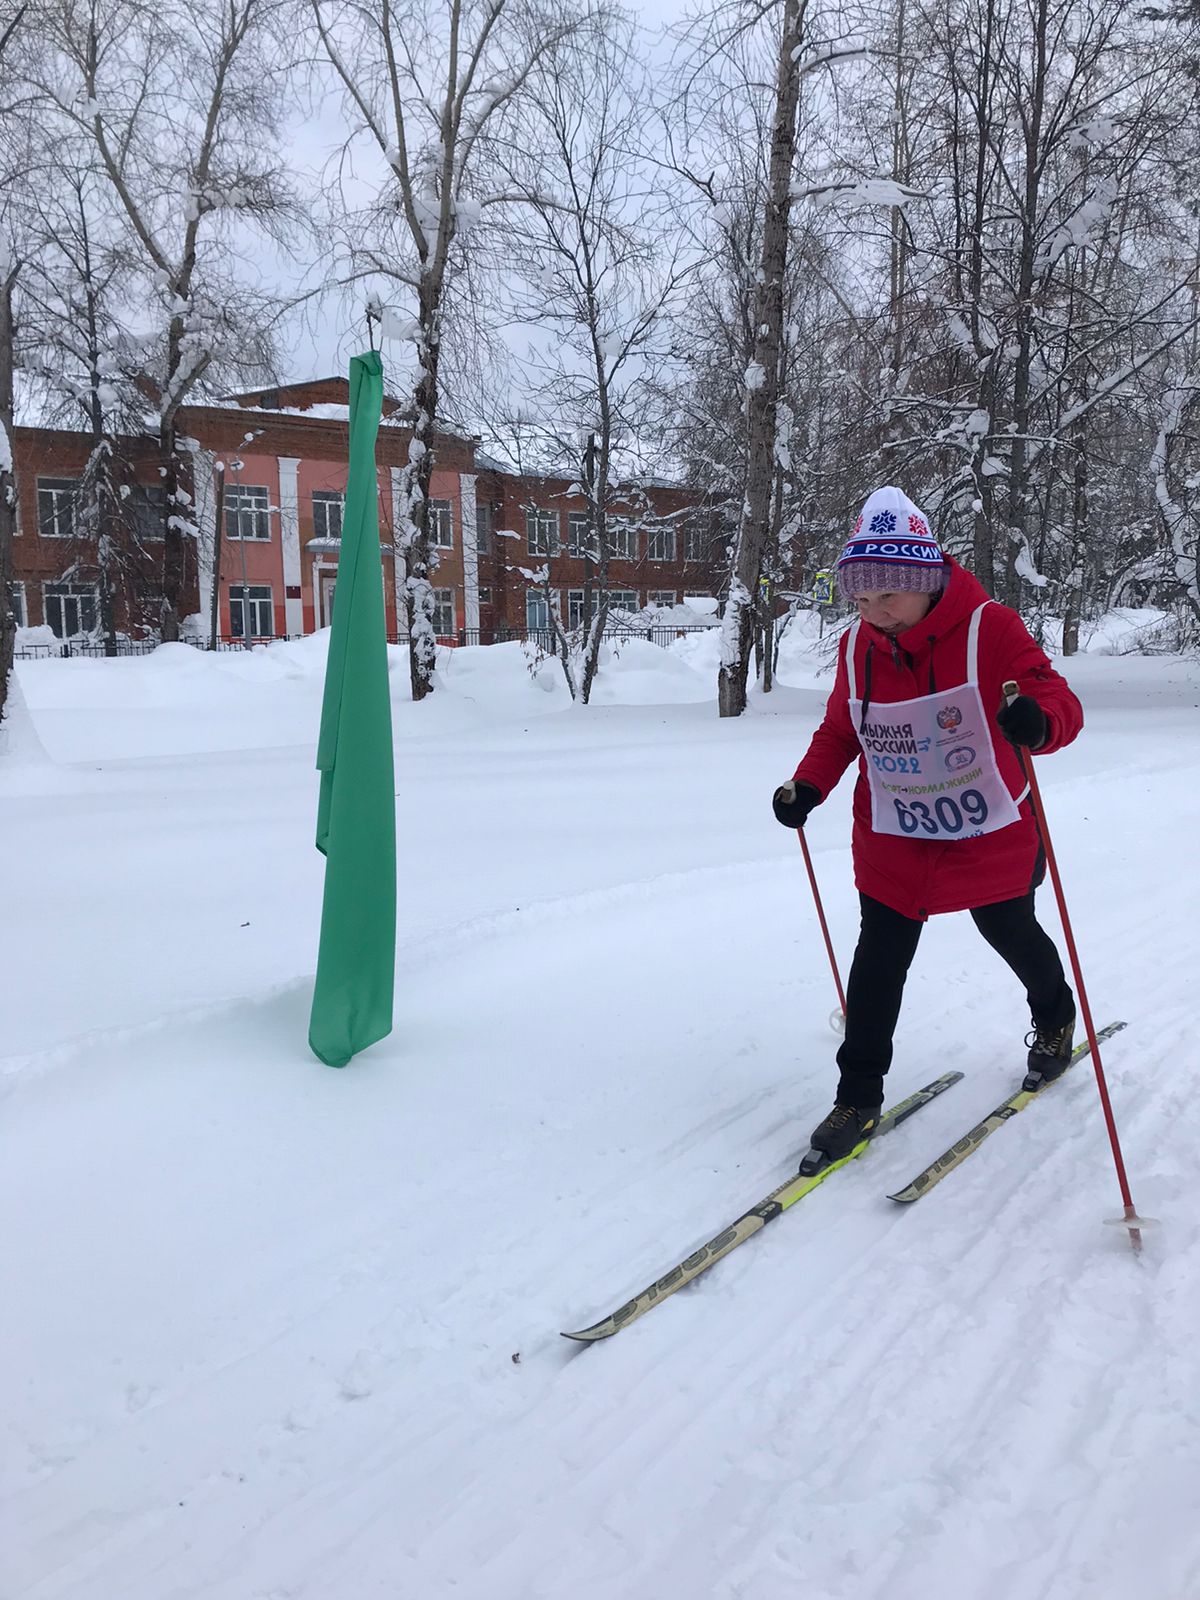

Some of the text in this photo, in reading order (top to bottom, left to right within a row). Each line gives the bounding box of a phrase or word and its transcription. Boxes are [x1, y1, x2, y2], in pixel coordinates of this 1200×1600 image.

[865, 543, 942, 559] РОССИИ
[865, 738, 918, 754] РОССИИ
[872, 754, 922, 774] 2022
[893, 788, 989, 835] 6309
